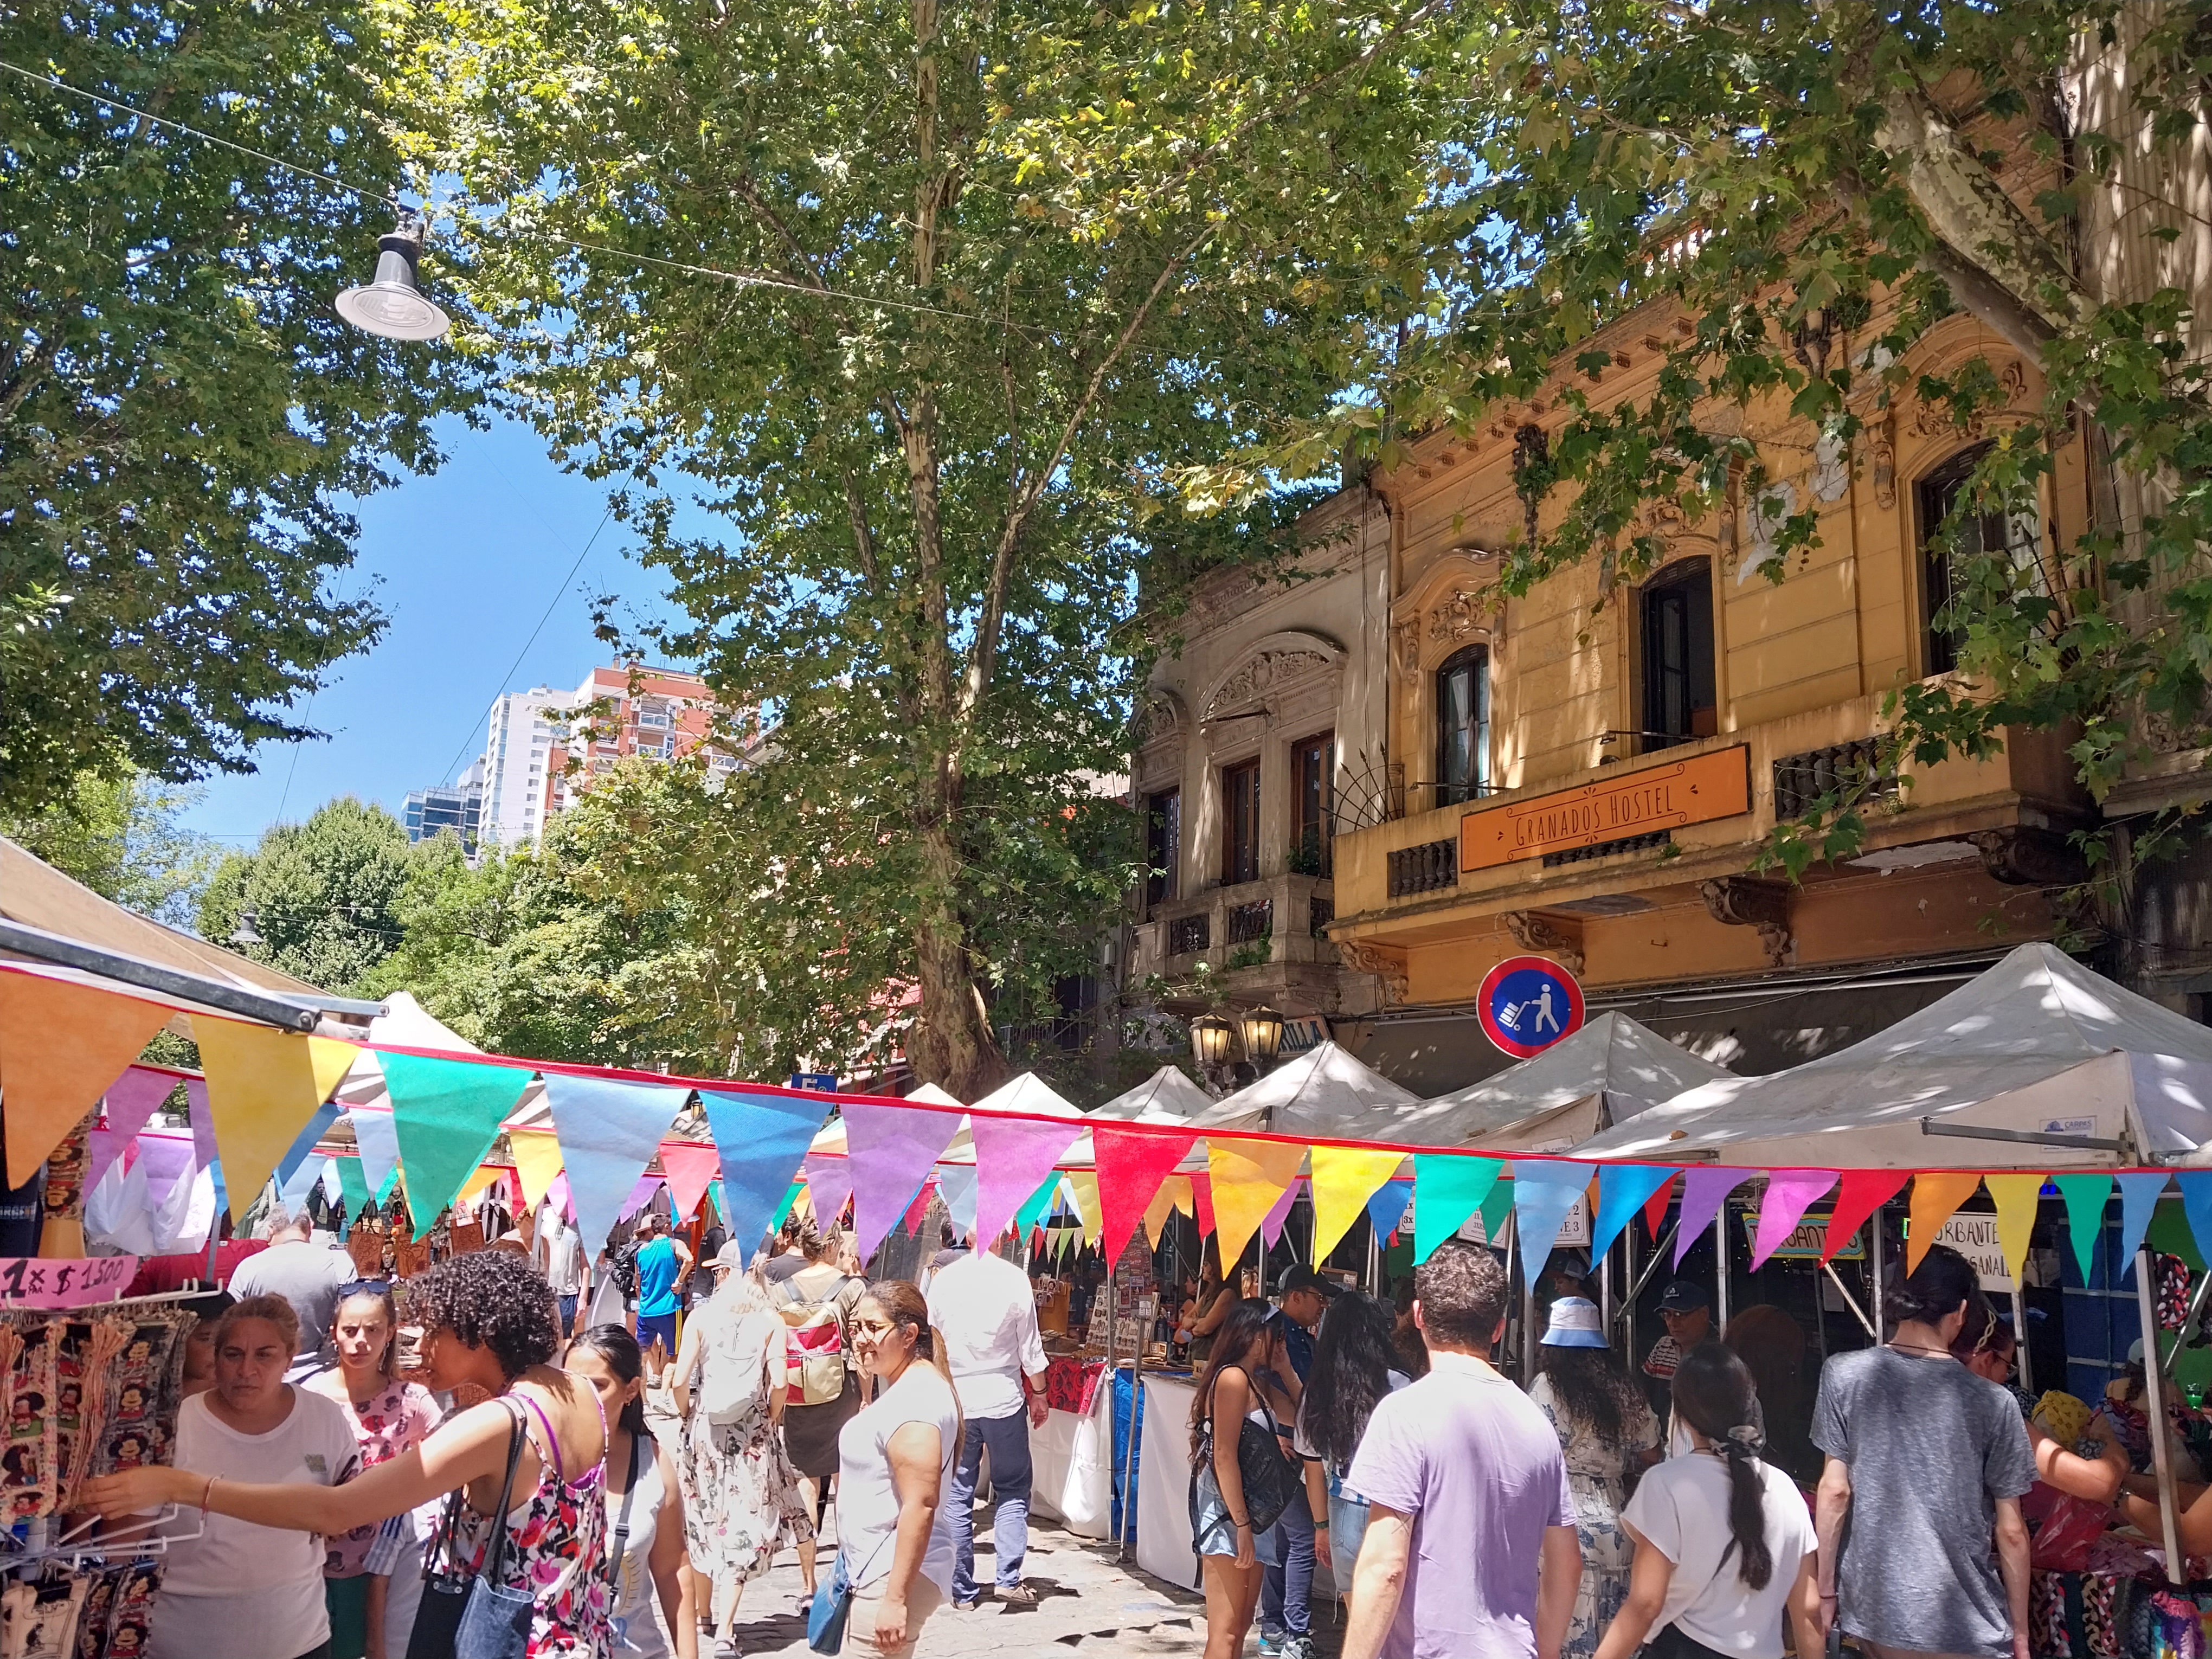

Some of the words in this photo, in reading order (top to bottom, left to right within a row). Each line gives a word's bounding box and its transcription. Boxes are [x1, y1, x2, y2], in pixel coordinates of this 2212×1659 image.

[1516, 802, 1600, 846] GRANADOS
[1610, 785, 1673, 824] HOSTEL
[1, 1259, 28, 1298] 1
[52, 1265, 76, 1296] $
